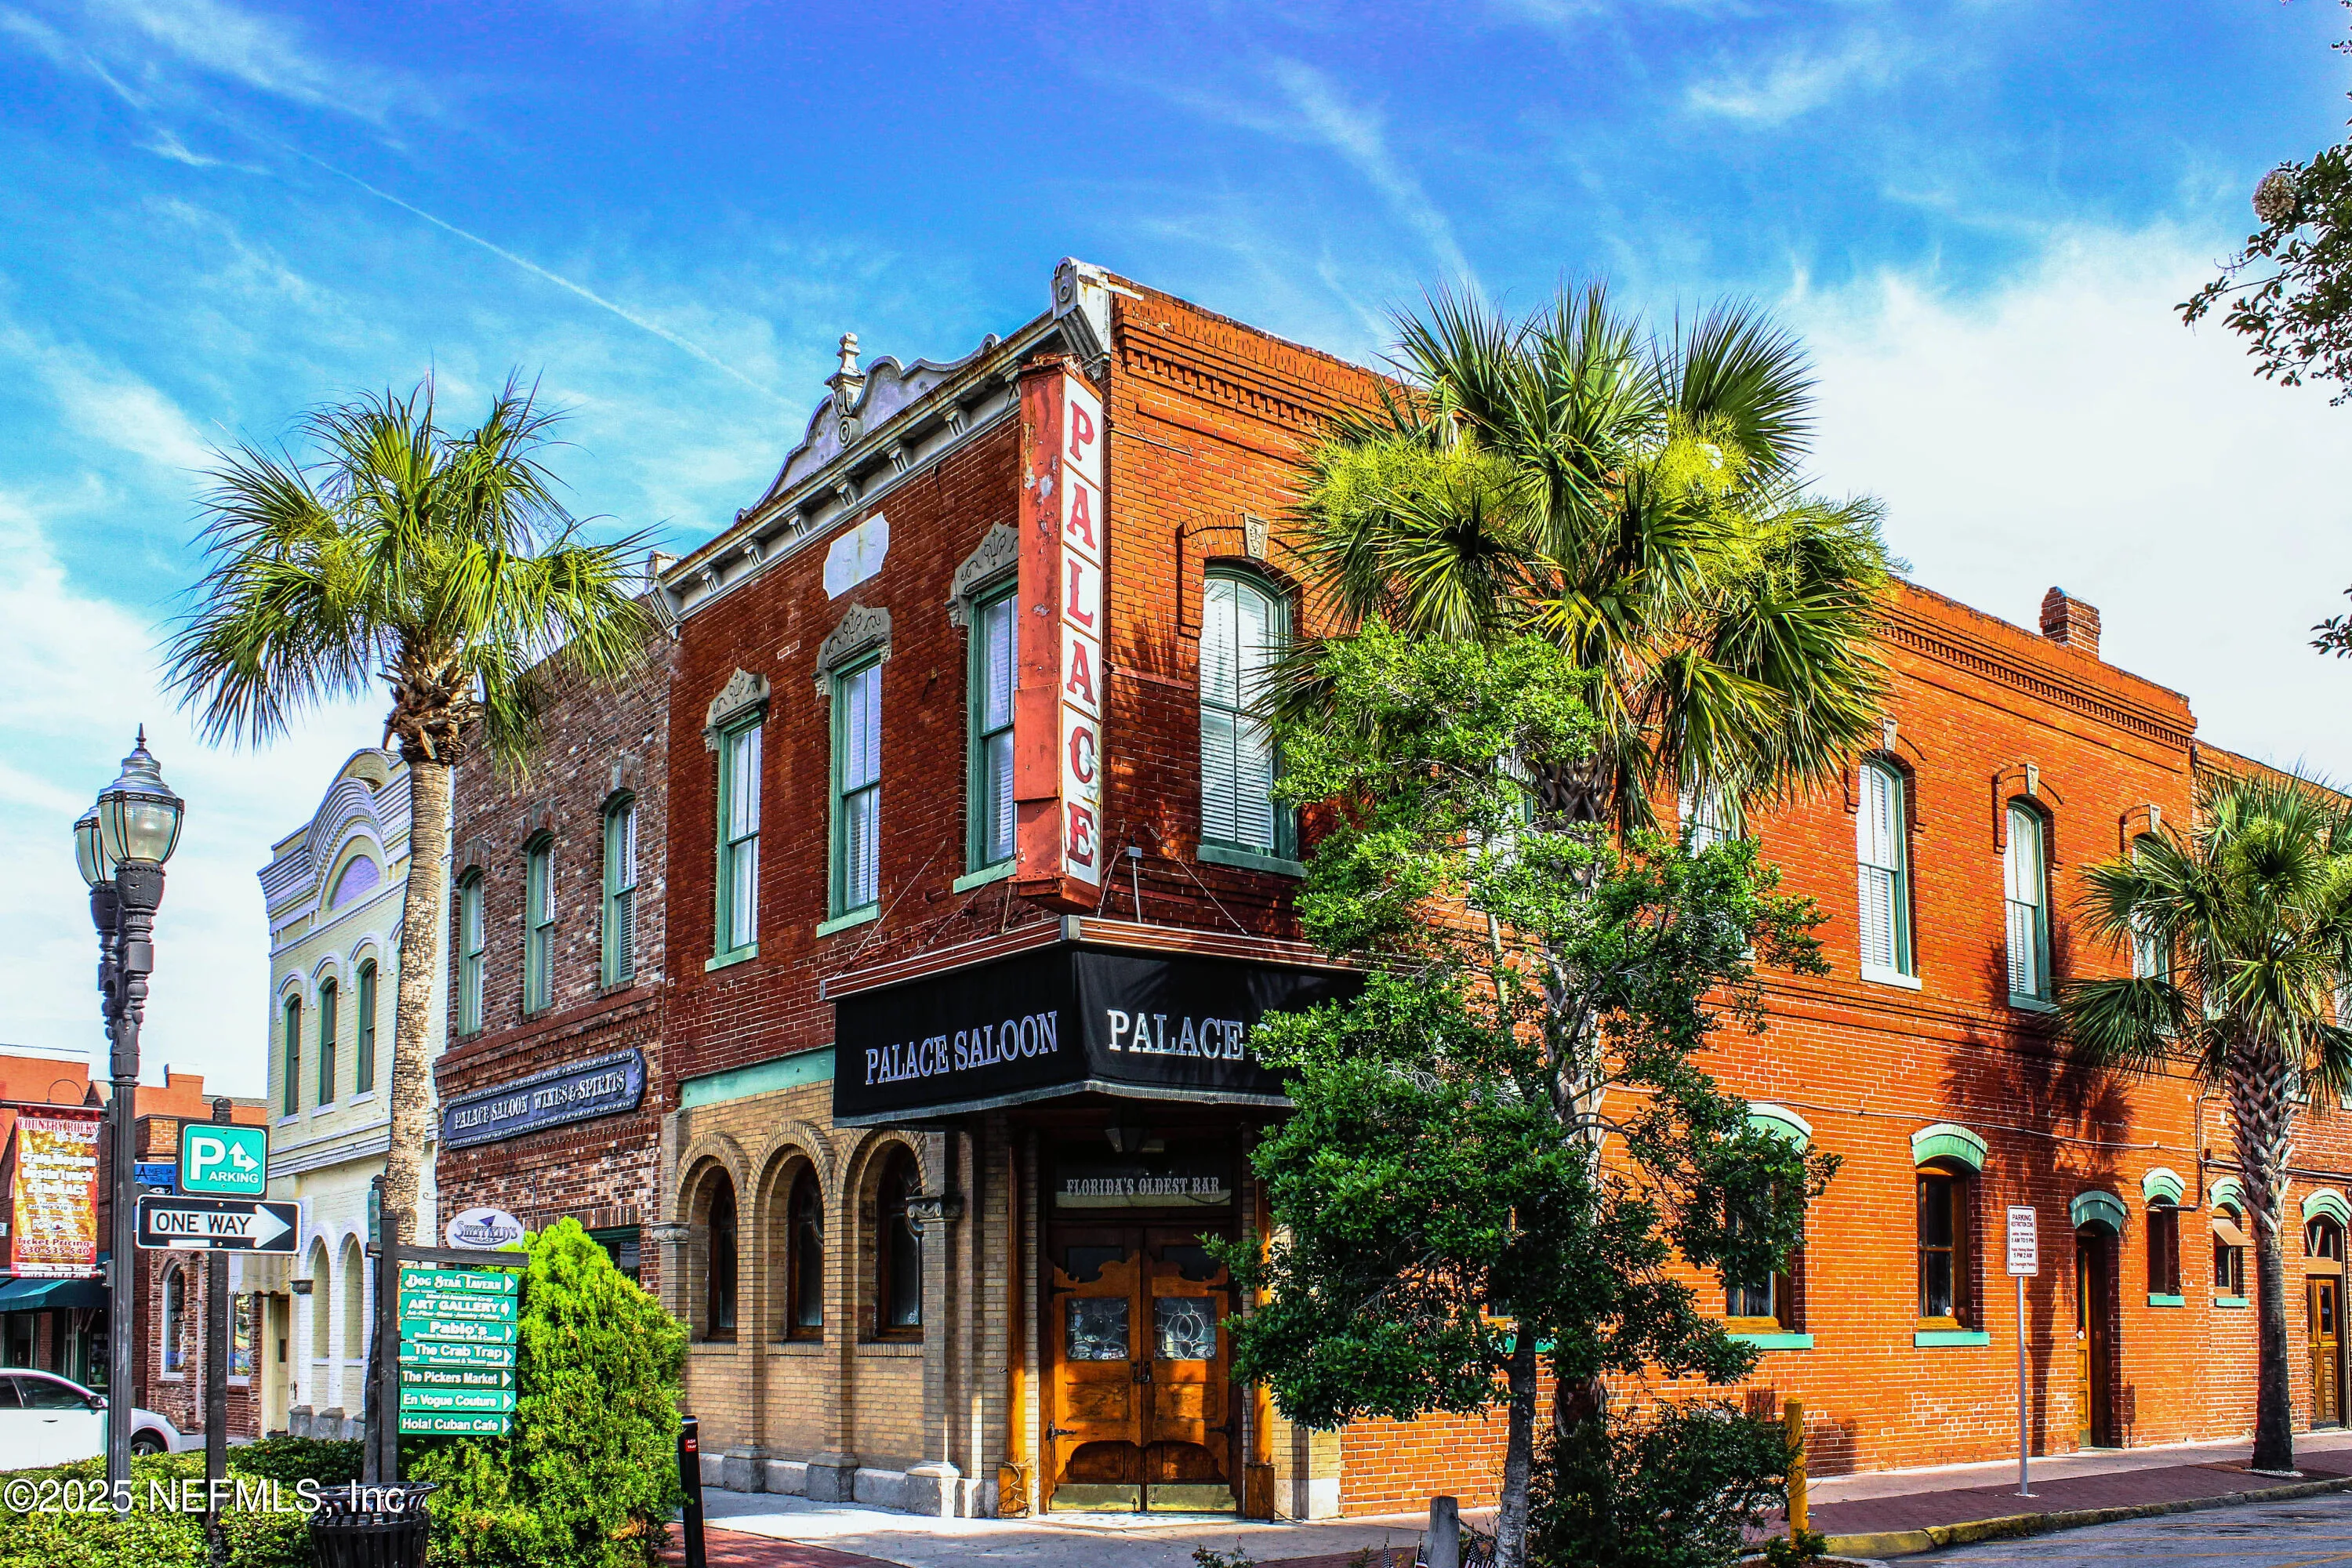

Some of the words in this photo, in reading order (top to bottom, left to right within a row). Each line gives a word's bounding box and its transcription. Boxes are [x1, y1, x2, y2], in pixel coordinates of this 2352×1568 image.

[1066, 399, 1097, 868] PALACE
[1106, 1009, 1243, 1060] PALACE
[866, 1035, 949, 1085] PALACE
[954, 1011, 1058, 1071] SALOON
[454, 1105, 491, 1130] PALACE
[492, 1094, 530, 1121] SALOON
[533, 1083, 568, 1111] WINES
[579, 1070, 626, 1099] SPIRITS
[19, 1118, 64, 1131] COUNTRY
[67, 1121, 98, 1134] ROCKS
[1066, 1178, 1134, 1196] FLORIDA'S
[1138, 1178, 1188, 1196] OLDEST
[1192, 1177, 1220, 1195] BAR
[157, 1212, 199, 1232] ONE
[208, 1214, 252, 1235] WAY
[405, 1274, 431, 1288] DOG
[434, 1275, 462, 1289] STAR
[456, 1273, 502, 1290] TAVERN
[408, 1299, 436, 1309] ART
[438, 1300, 499, 1312] GALLERY
[430, 1321, 488, 1335] Pablo's
[413, 1343, 437, 1356] The
[440, 1344, 471, 1357] Crab
[474, 1346, 503, 1359] Trap
[402, 1370, 422, 1382] The
[423, 1370, 461, 1383] Pickers
[463, 1372, 498, 1385] Market
[403, 1393, 418, 1405] En
[419, 1394, 453, 1408] Vogue
[455, 1395, 497, 1407] Couture
[401, 1417, 432, 1429] Hola!
[434, 1418, 470, 1431] Cuban
[473, 1419, 499, 1431] Cafe
